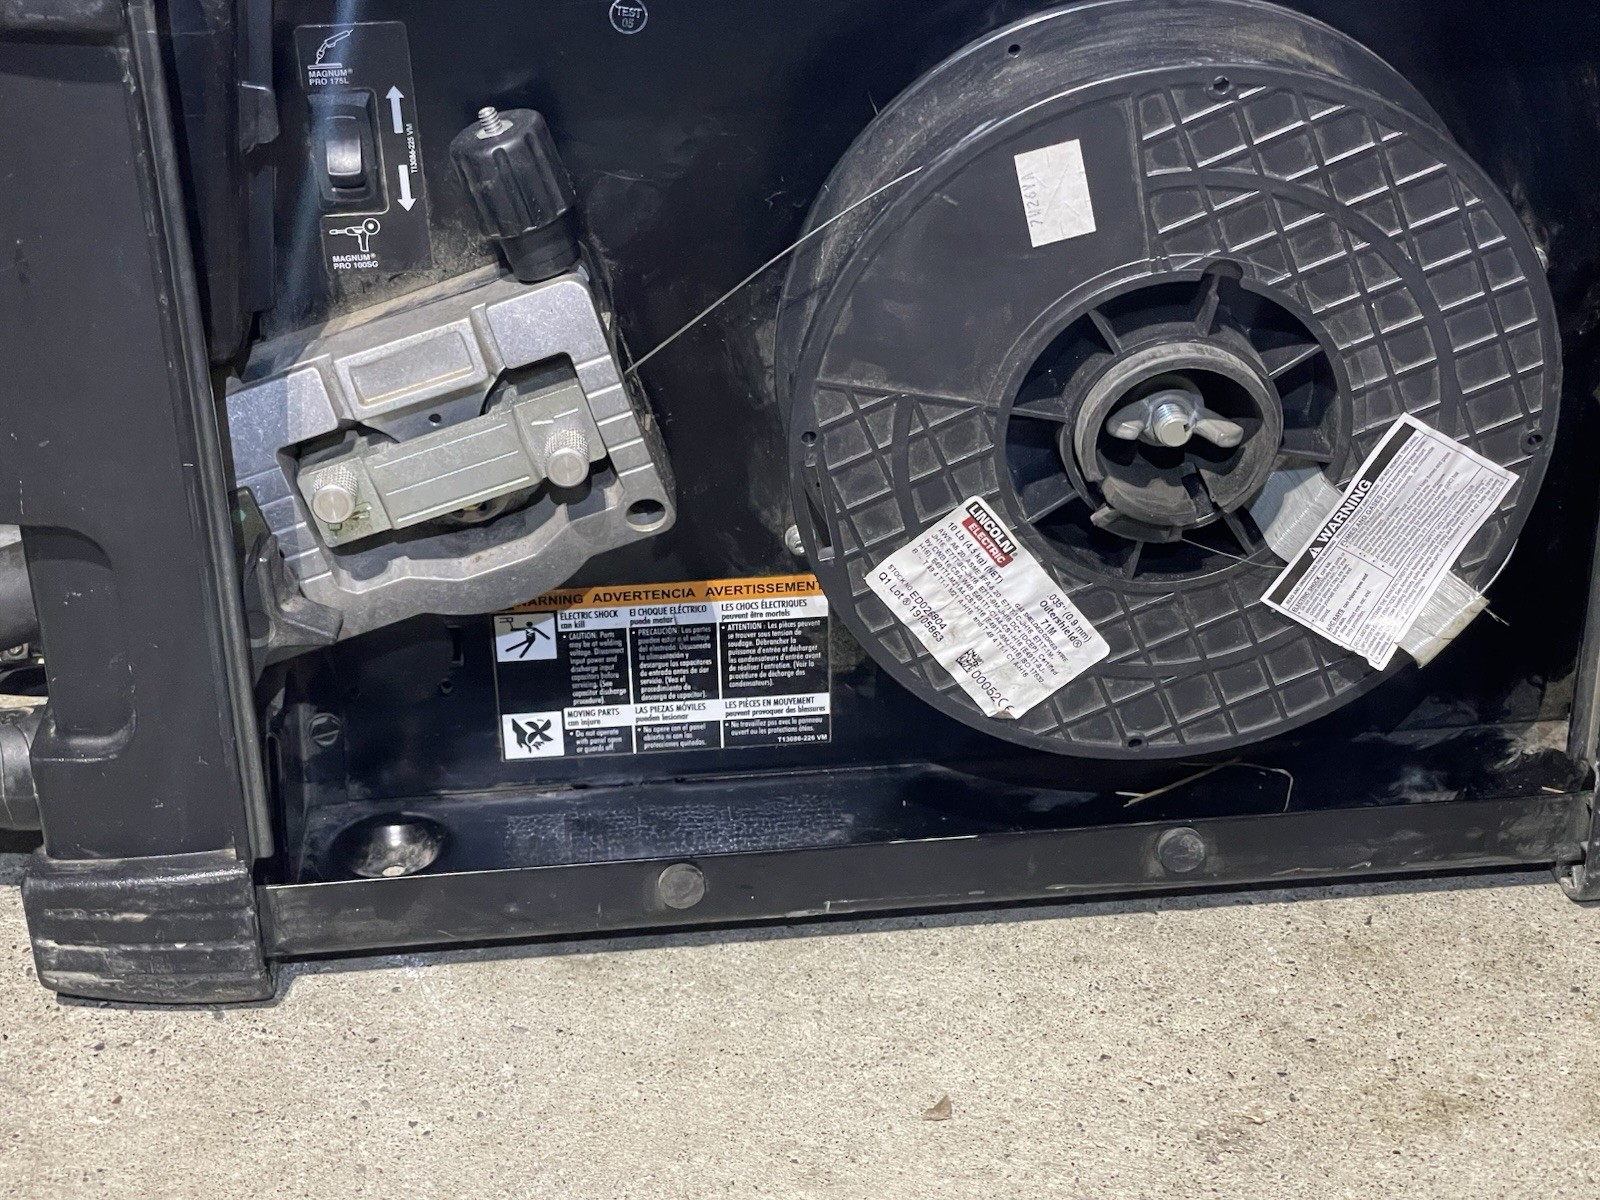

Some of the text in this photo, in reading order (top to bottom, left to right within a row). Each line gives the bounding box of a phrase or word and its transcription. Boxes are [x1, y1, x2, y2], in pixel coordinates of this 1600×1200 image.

[615, 5, 642, 18] TEST
[406, 123, 413, 136] VM
[354, 260, 378, 268] 100SG
[1316, 477, 1372, 543] WARNING
[1355, 513, 1367, 527] AND
[967, 502, 1014, 554] LINCOLN
[967, 521, 1006, 564] ELECTRIC
[947, 521, 1003, 585] 10 Lb (4.5 kg) (NET)
[887, 563, 906, 584] STOCK
[877, 570, 891, 585] Q1
[889, 583, 904, 599] Lot
[519, 593, 584, 606] ARNING
[592, 588, 696, 603] ADVERTENCIA
[638, 607, 668, 616] CHOQUE
[670, 604, 707, 614] ELÉCTRICO
[722, 599, 807, 611] LES CHOCS ÉLECTRIQUES
[560, 610, 618, 620] ELECTRIC SHOCK
[722, 612, 748, 622] peuvent
[765, 609, 790, 617] mortels
[630, 618, 651, 626] puede
[727, 622, 762, 631] ATTENTION
[779, 620, 796, 629] pièces
[797, 620, 821, 628] peuvent
[1038, 598, 1083, 649] Outershield®
[1039, 618, 1057, 636] 71M
[1061, 609, 1079, 628] (0.9
[1073, 623, 1092, 643] mm)
[729, 664, 737, 672] de
[970, 668, 1001, 702] 00052
[650, 705, 674, 713] PIEZAS
[676, 702, 706, 711] MÓVILES
[725, 701, 736, 709] LES
[738, 698, 761, 708] PIÈCES
[773, 697, 815, 706] MOUVEMENT
[567, 708, 620, 718] MOVING PARTS
[725, 710, 750, 718] peuvent
[752, 708, 783, 717] provoquer
[798, 705, 826, 713] blessures
[581, 718, 600, 727] injure
